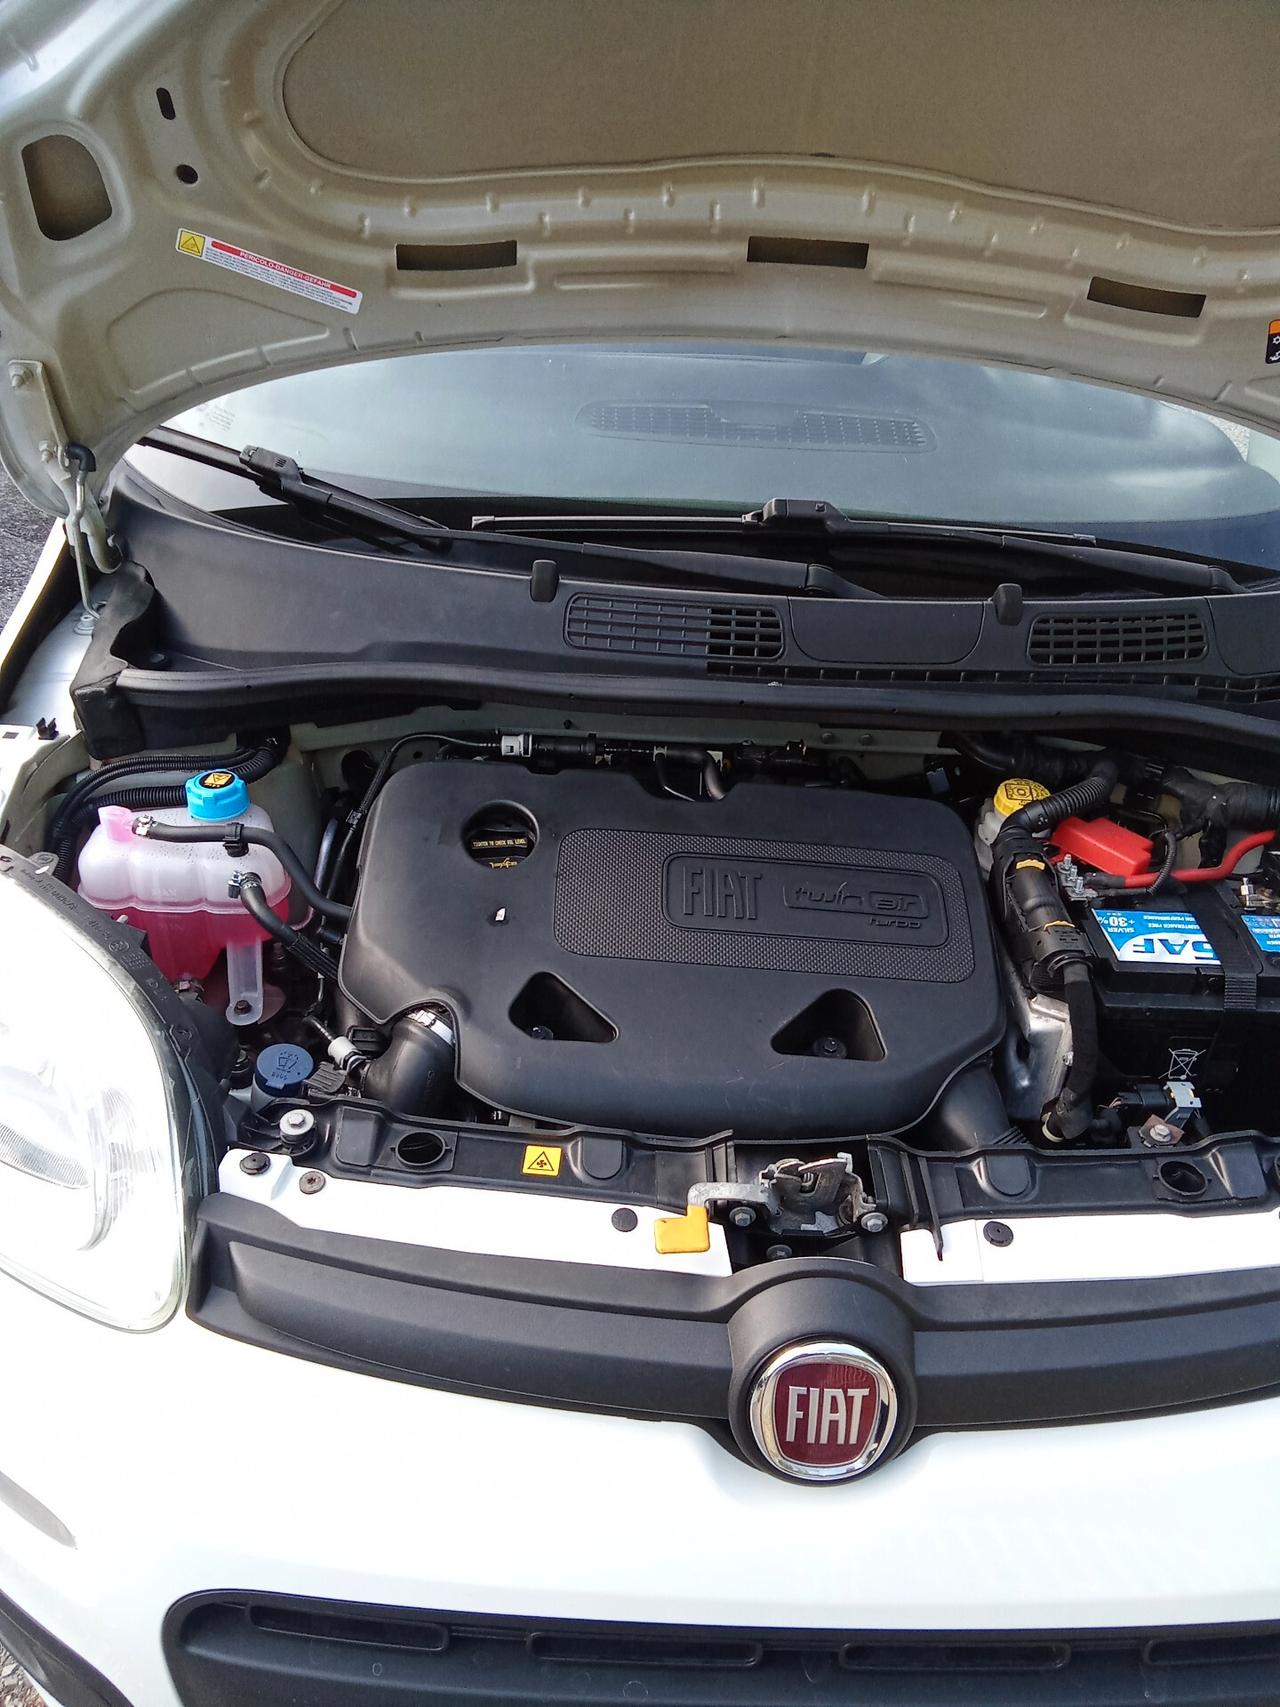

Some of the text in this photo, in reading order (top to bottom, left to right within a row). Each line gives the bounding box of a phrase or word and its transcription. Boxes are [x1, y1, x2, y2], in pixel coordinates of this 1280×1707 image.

[683, 864, 763, 920] FIAT
[869, 917, 921, 929] turbo
[1107, 926, 1135, 934] SILVER
[785, 1385, 870, 1445] FIAT
